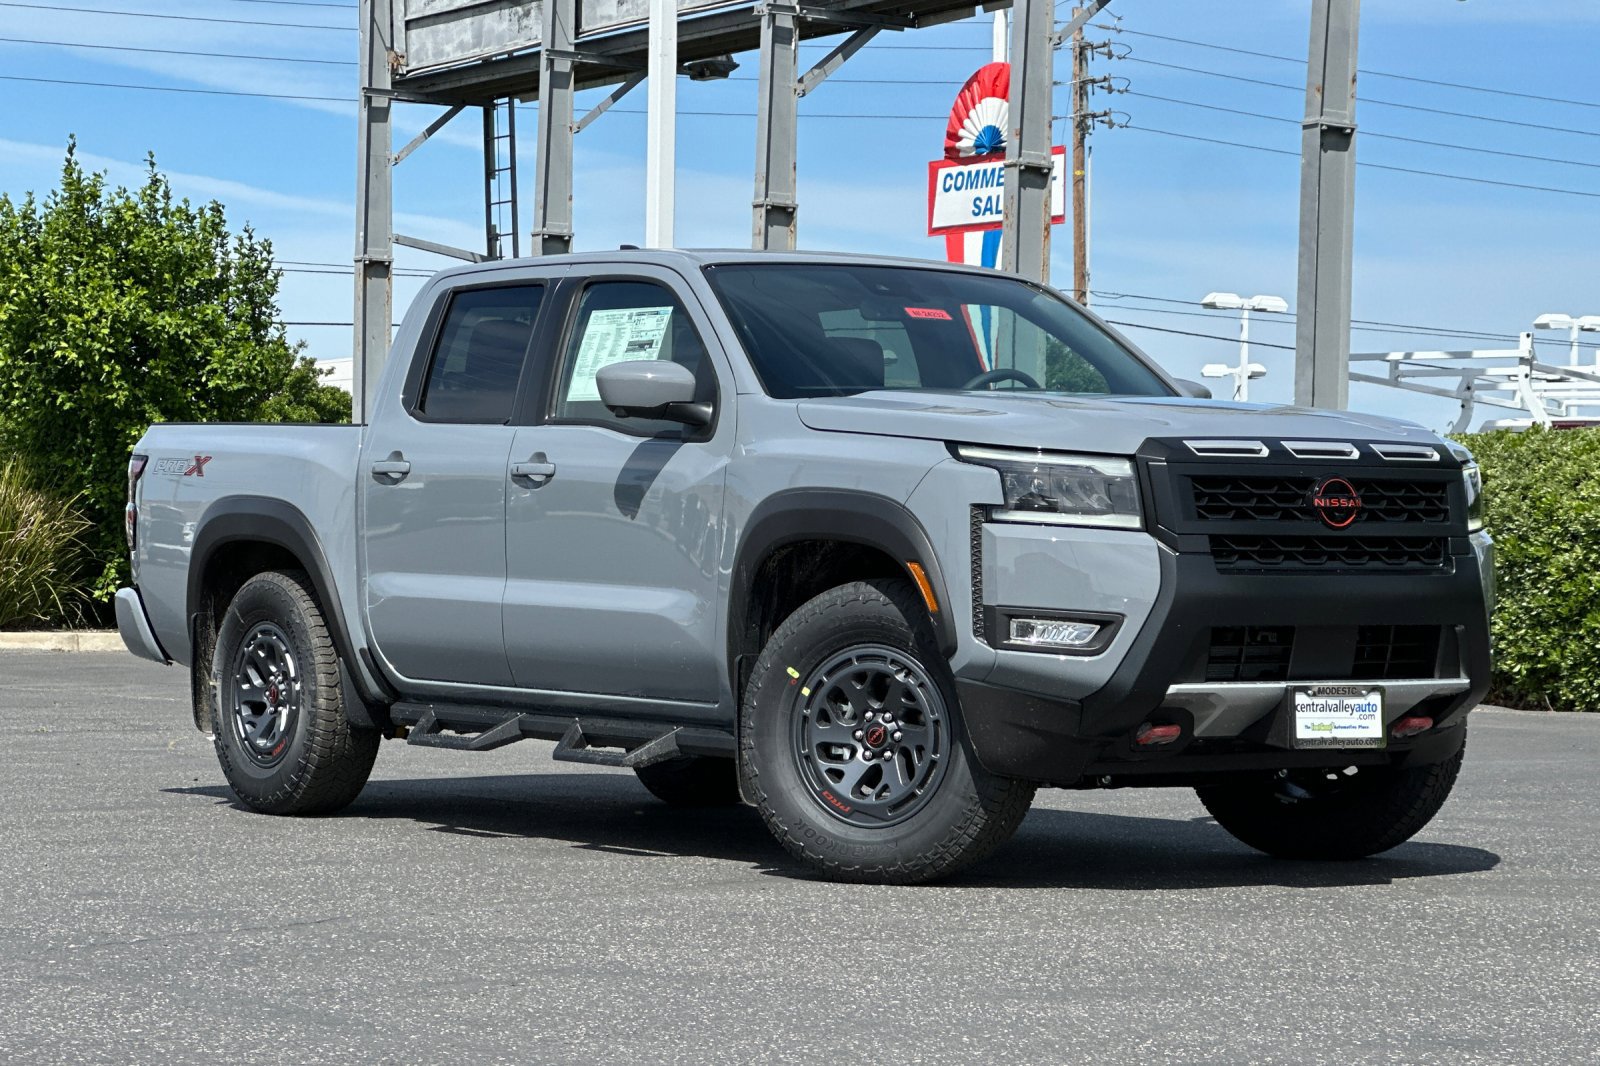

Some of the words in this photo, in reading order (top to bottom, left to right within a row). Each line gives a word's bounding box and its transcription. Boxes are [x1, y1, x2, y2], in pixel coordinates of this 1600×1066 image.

[942, 166, 1005, 193] COMME
[971, 194, 1003, 217] SAL
[1314, 498, 1361, 507] NISSAN
